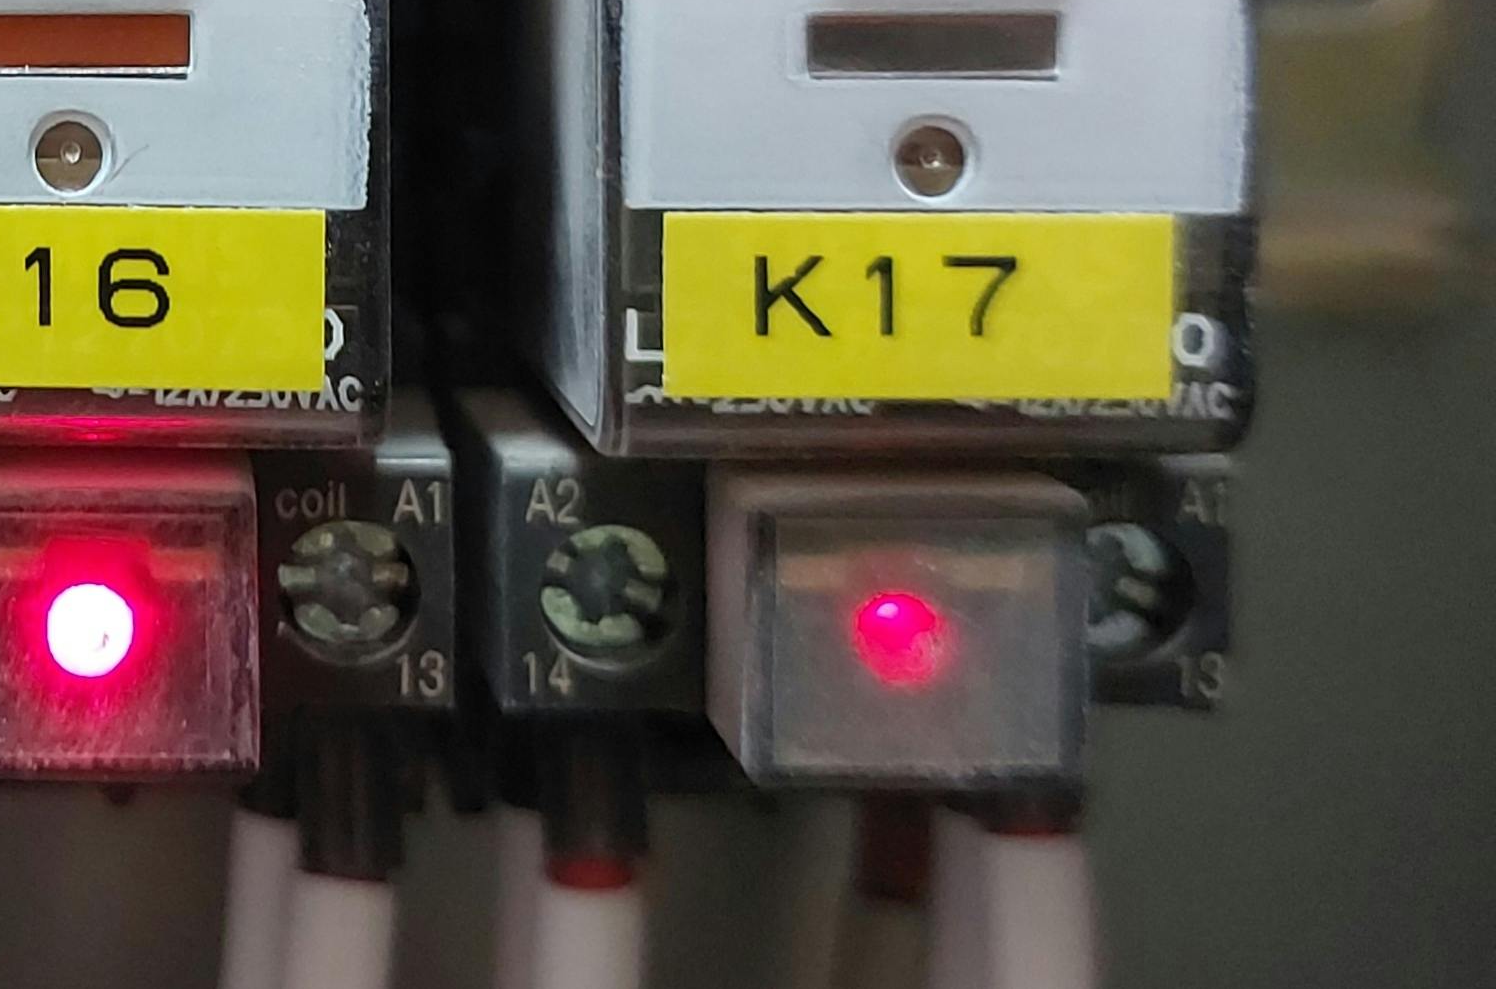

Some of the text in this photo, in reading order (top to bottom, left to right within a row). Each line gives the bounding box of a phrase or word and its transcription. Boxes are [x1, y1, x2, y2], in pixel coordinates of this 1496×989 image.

[753, 255, 1017, 338] K17
[275, 481, 444, 525] coil A1
[526, 479, 582, 524] A2
[399, 650, 447, 698] 13
[522, 652, 573, 696] 14
